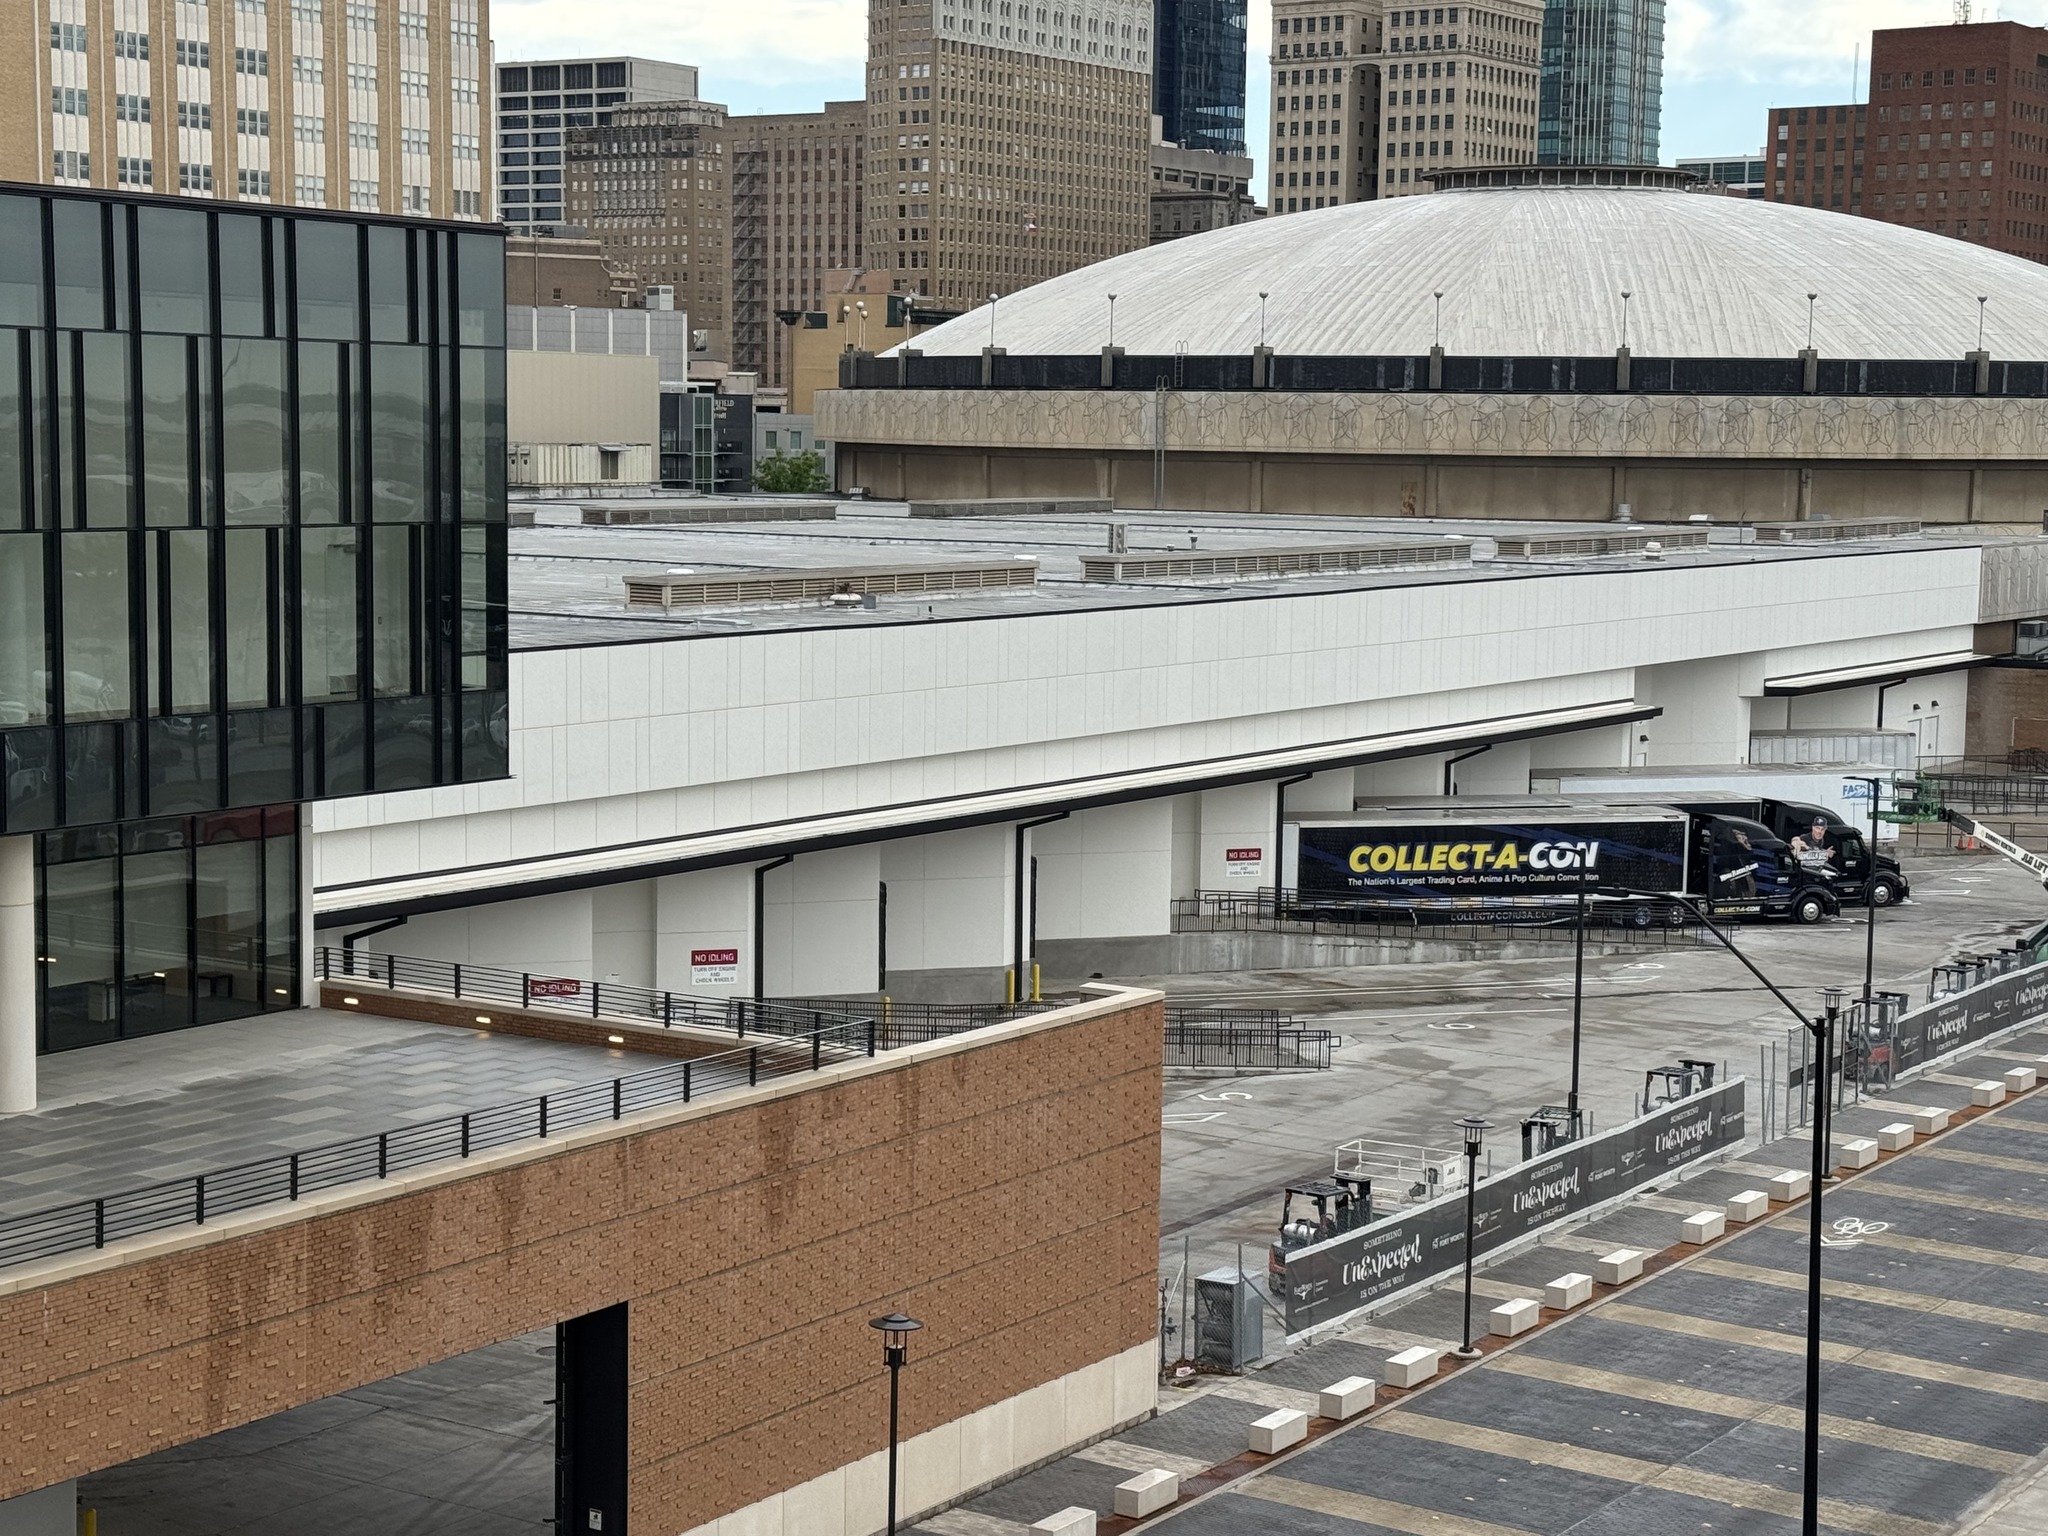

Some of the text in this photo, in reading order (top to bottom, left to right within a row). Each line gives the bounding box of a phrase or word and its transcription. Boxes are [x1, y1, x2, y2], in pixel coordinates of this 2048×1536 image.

[1228, 851, 1259, 859] NO IDLING
[1348, 841, 1599, 873] COLLECT-A-CON
[1348, 872, 1599, 887] The Nation's Largest Trading Card, Anime & Pop Culture Convetion
[694, 952, 735, 963] NO IDLING
[1197, 1091, 1253, 1101] 5
[1363, 1228, 1403, 1250] SOMETHING
[1367, 1285, 1378, 1297] ON
[1379, 1279, 1392, 1292] THE
[1392, 1273, 1406, 1286] WAY
